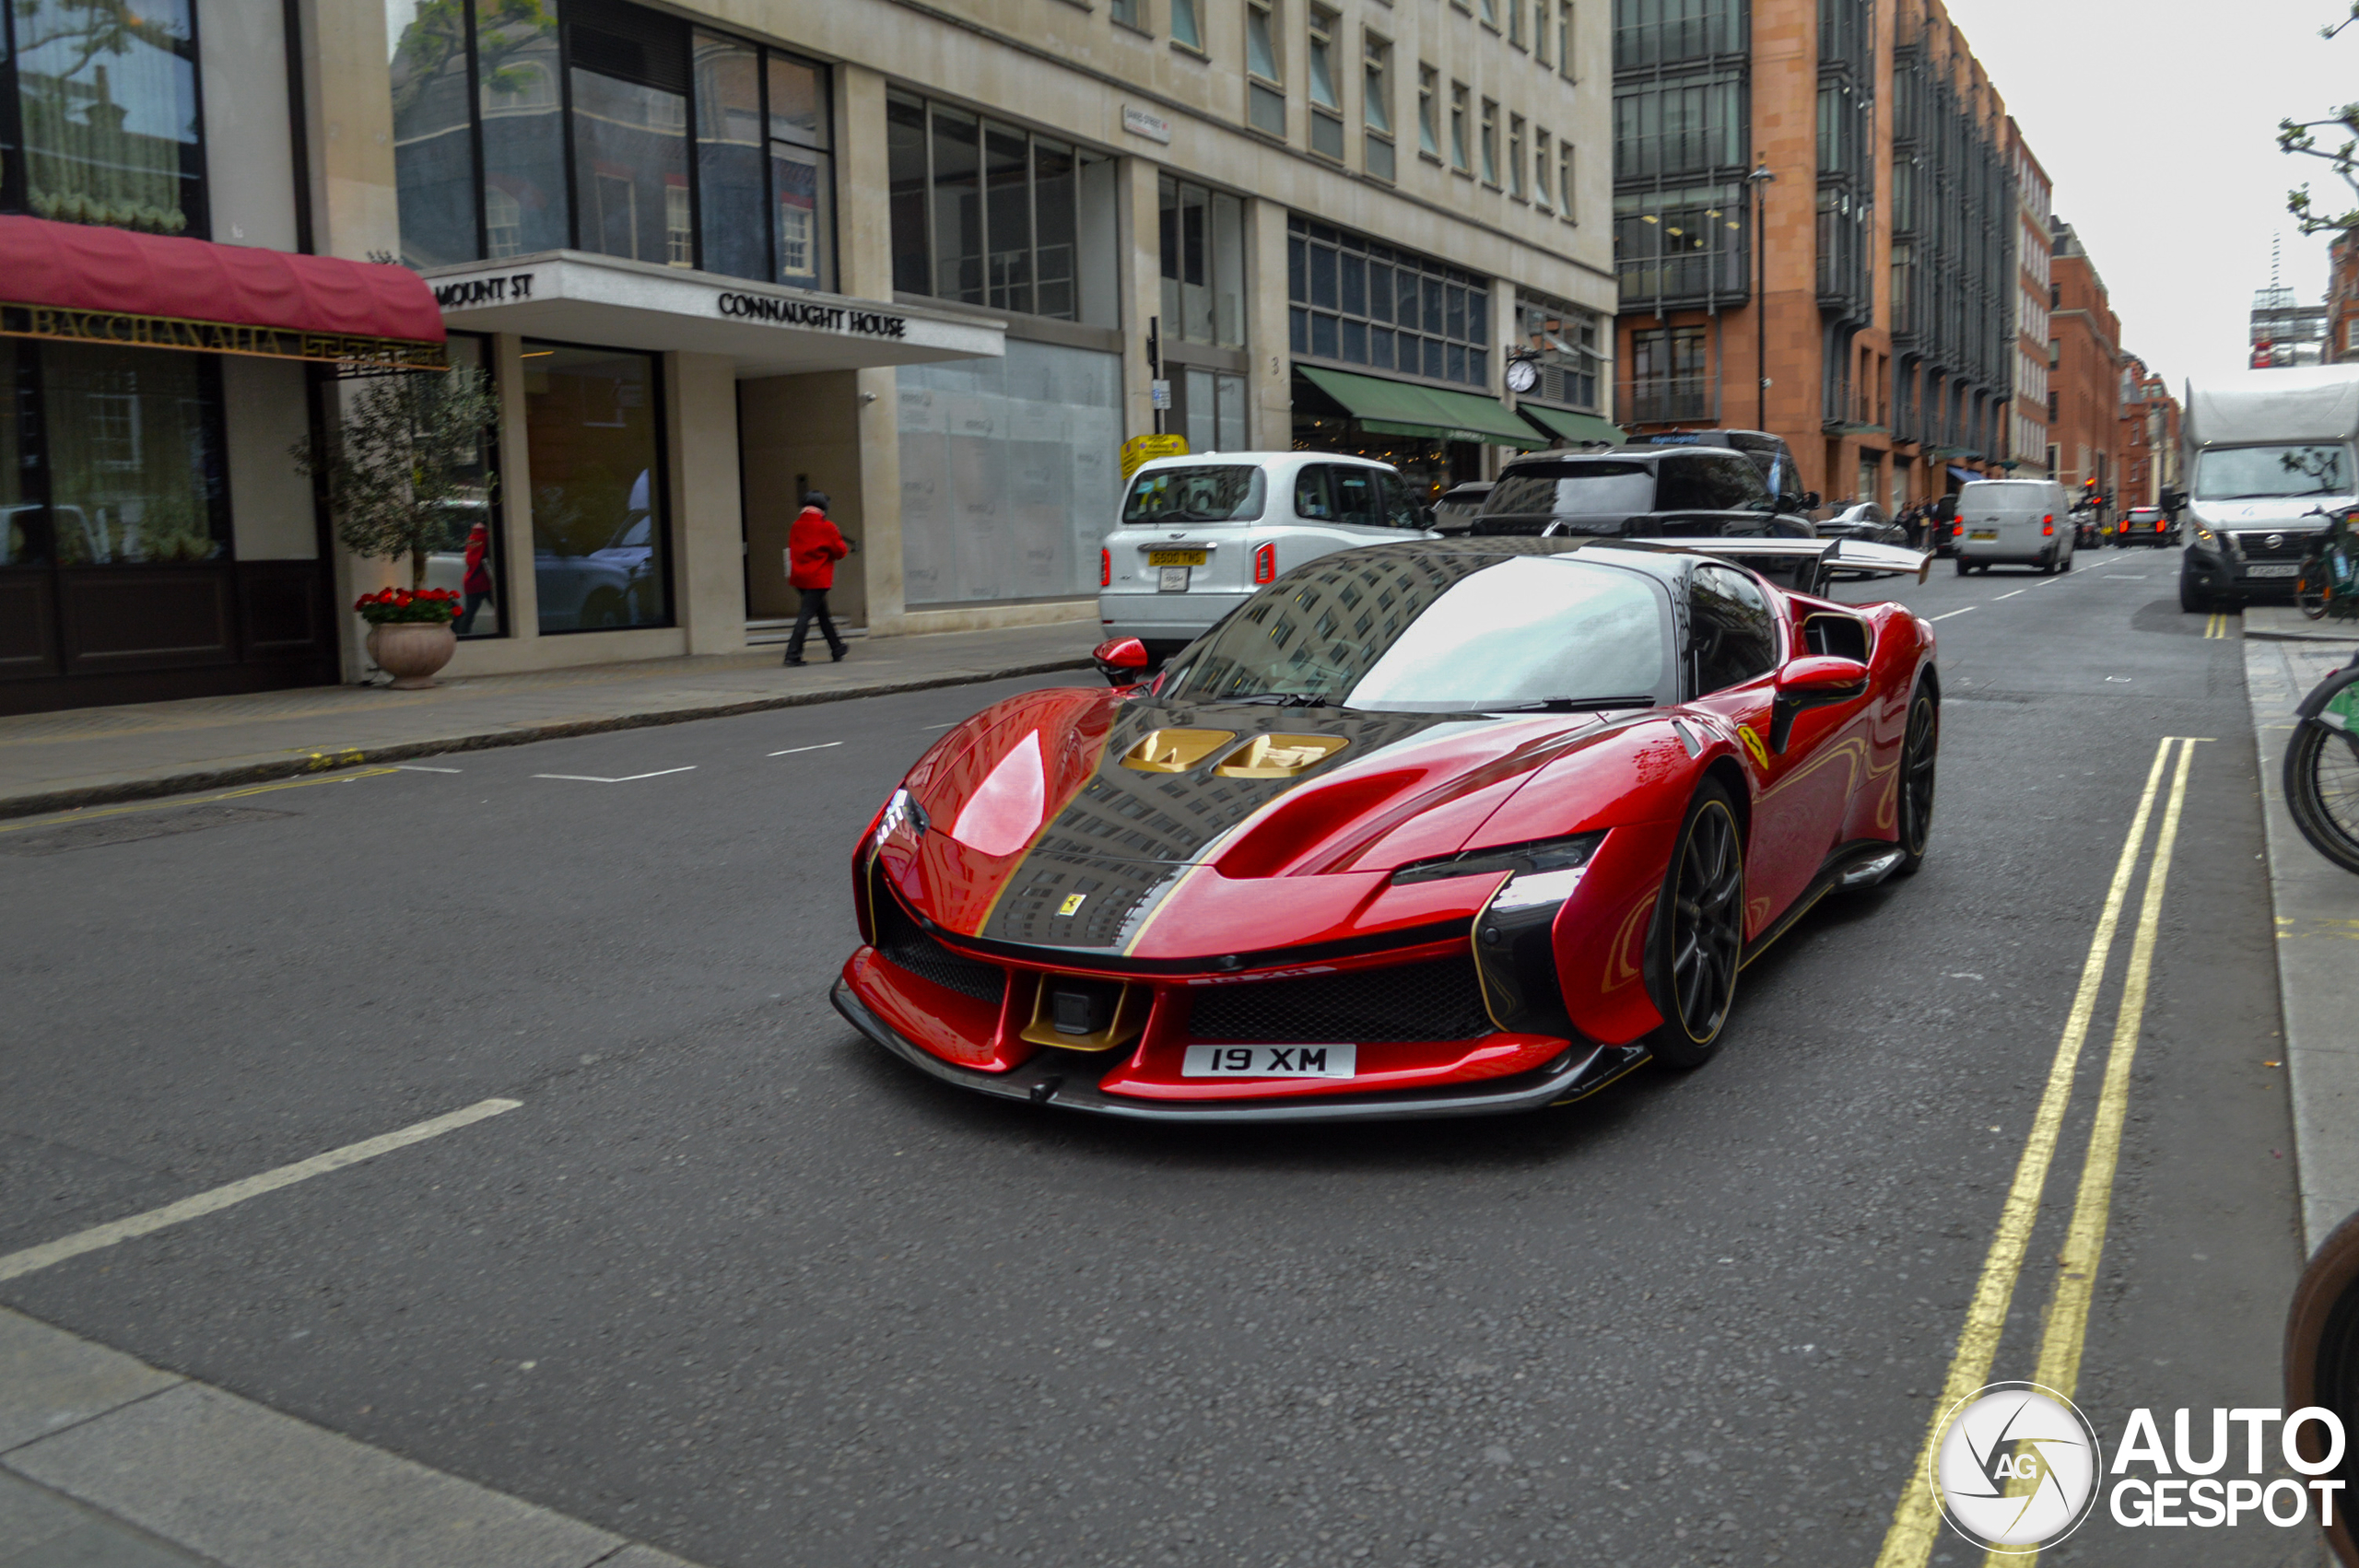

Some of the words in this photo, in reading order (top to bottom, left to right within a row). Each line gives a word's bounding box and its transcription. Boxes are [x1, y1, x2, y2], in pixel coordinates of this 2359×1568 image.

[434, 277, 507, 306] MOUNT
[511, 274, 534, 297] ST
[30, 307, 282, 356] BACCHANALIA
[718, 292, 845, 330] CONNAUGHT
[849, 310, 907, 338] HOUSE
[1211, 1048, 1252, 1071] 19
[1267, 1048, 1327, 1071] XM
